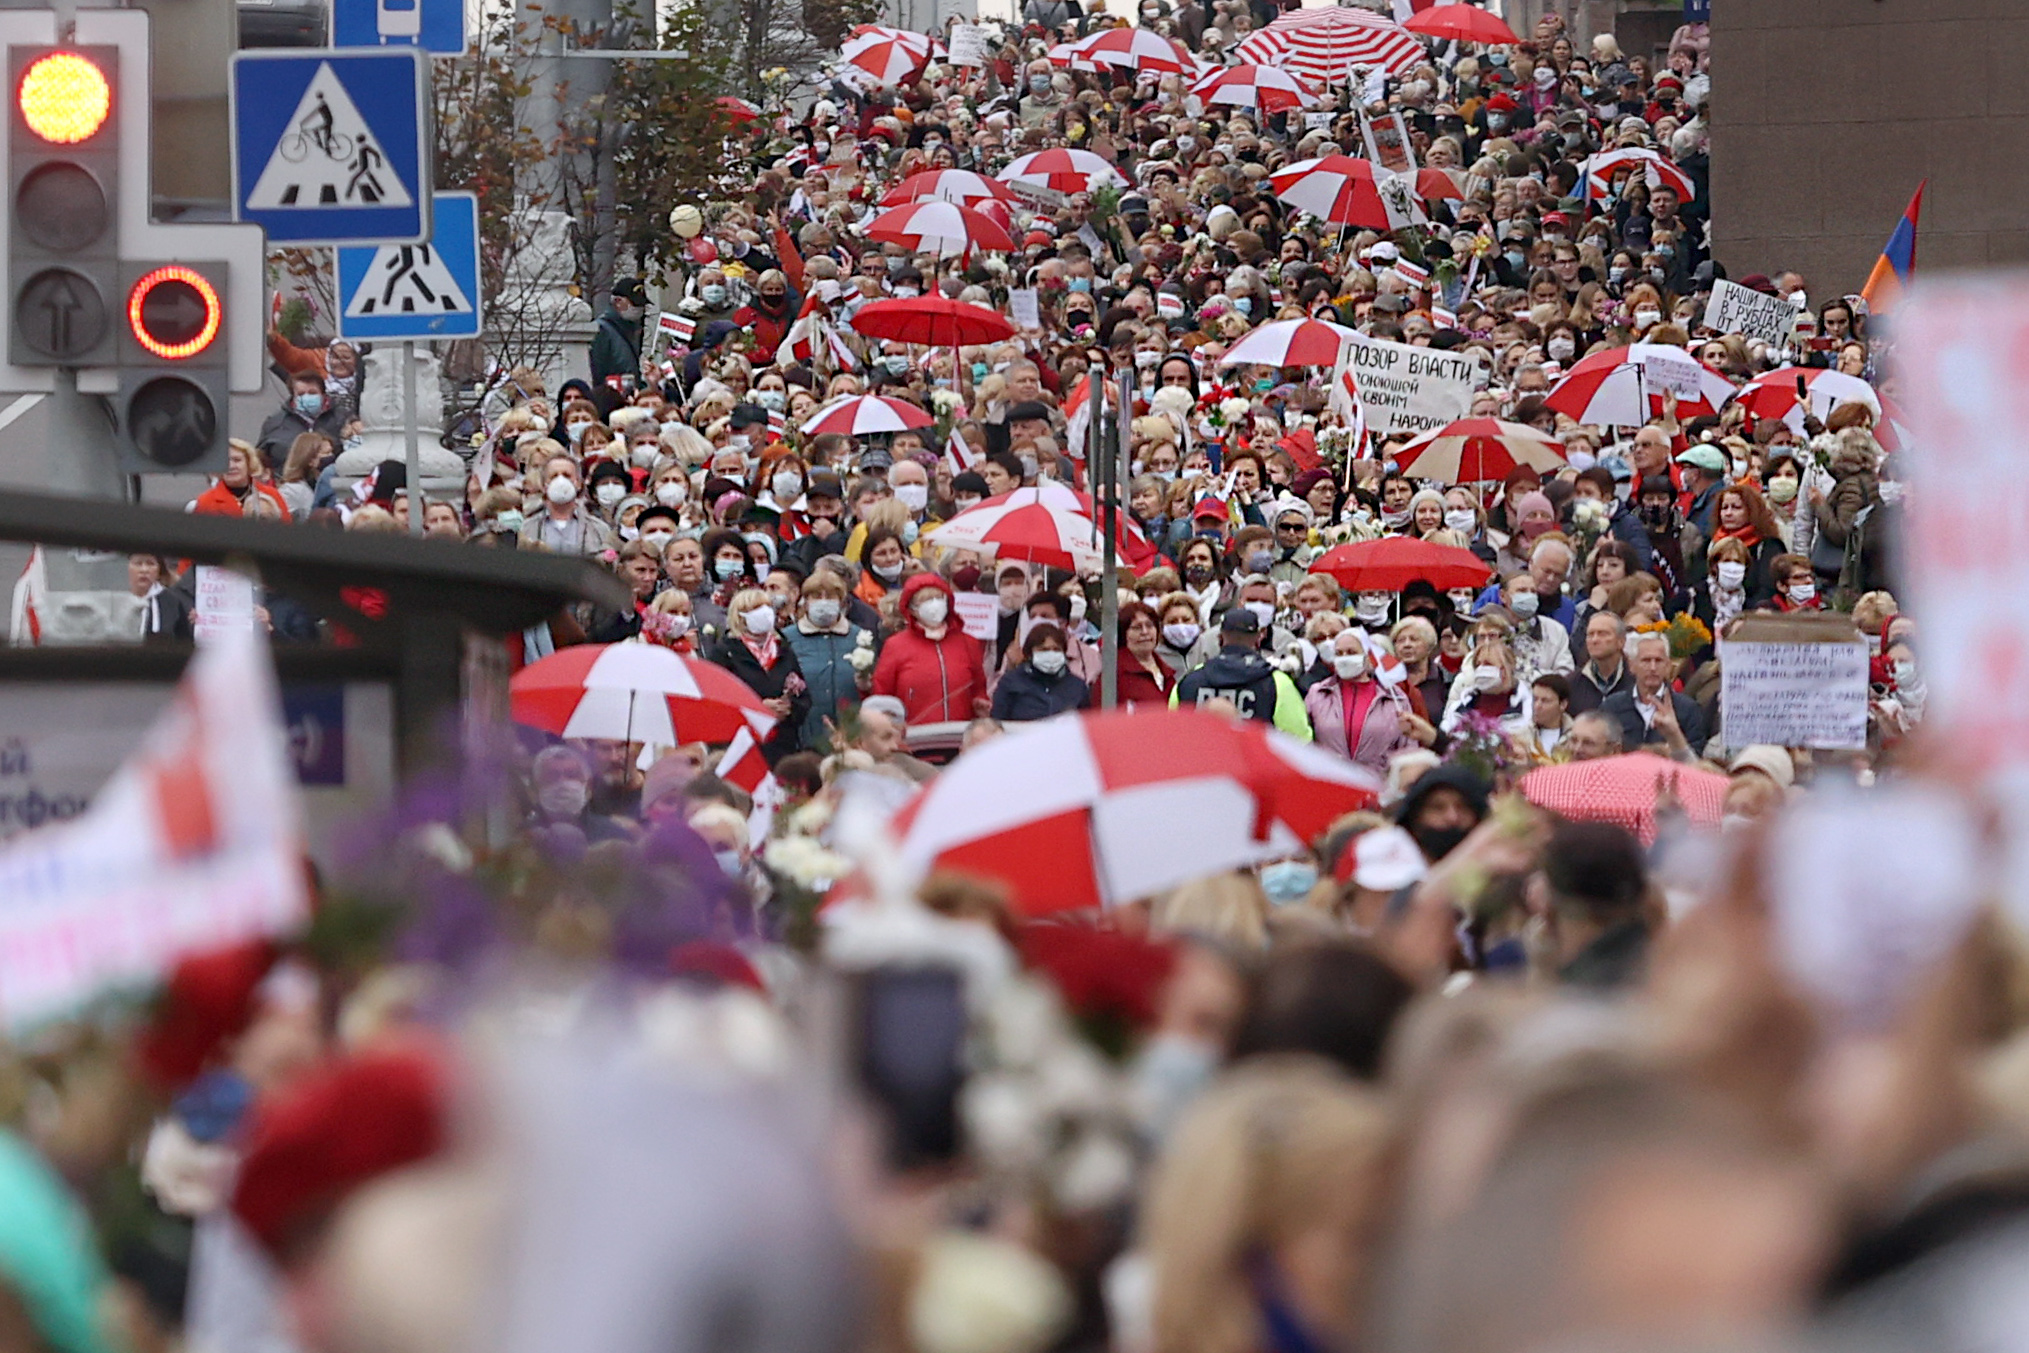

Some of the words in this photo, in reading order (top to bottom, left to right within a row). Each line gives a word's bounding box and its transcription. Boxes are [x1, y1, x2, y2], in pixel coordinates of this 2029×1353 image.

[1725, 284, 1759, 307] НАШИ
[1762, 297, 1795, 320] ДУШИ
[1717, 315, 1733, 331] ОТ
[1721, 300, 1729, 315] В
[1735, 305, 1783, 332] РУБЦАХ
[1347, 343, 1398, 370] ПОЗОР
[1363, 391, 1407, 409] СВОИМ
